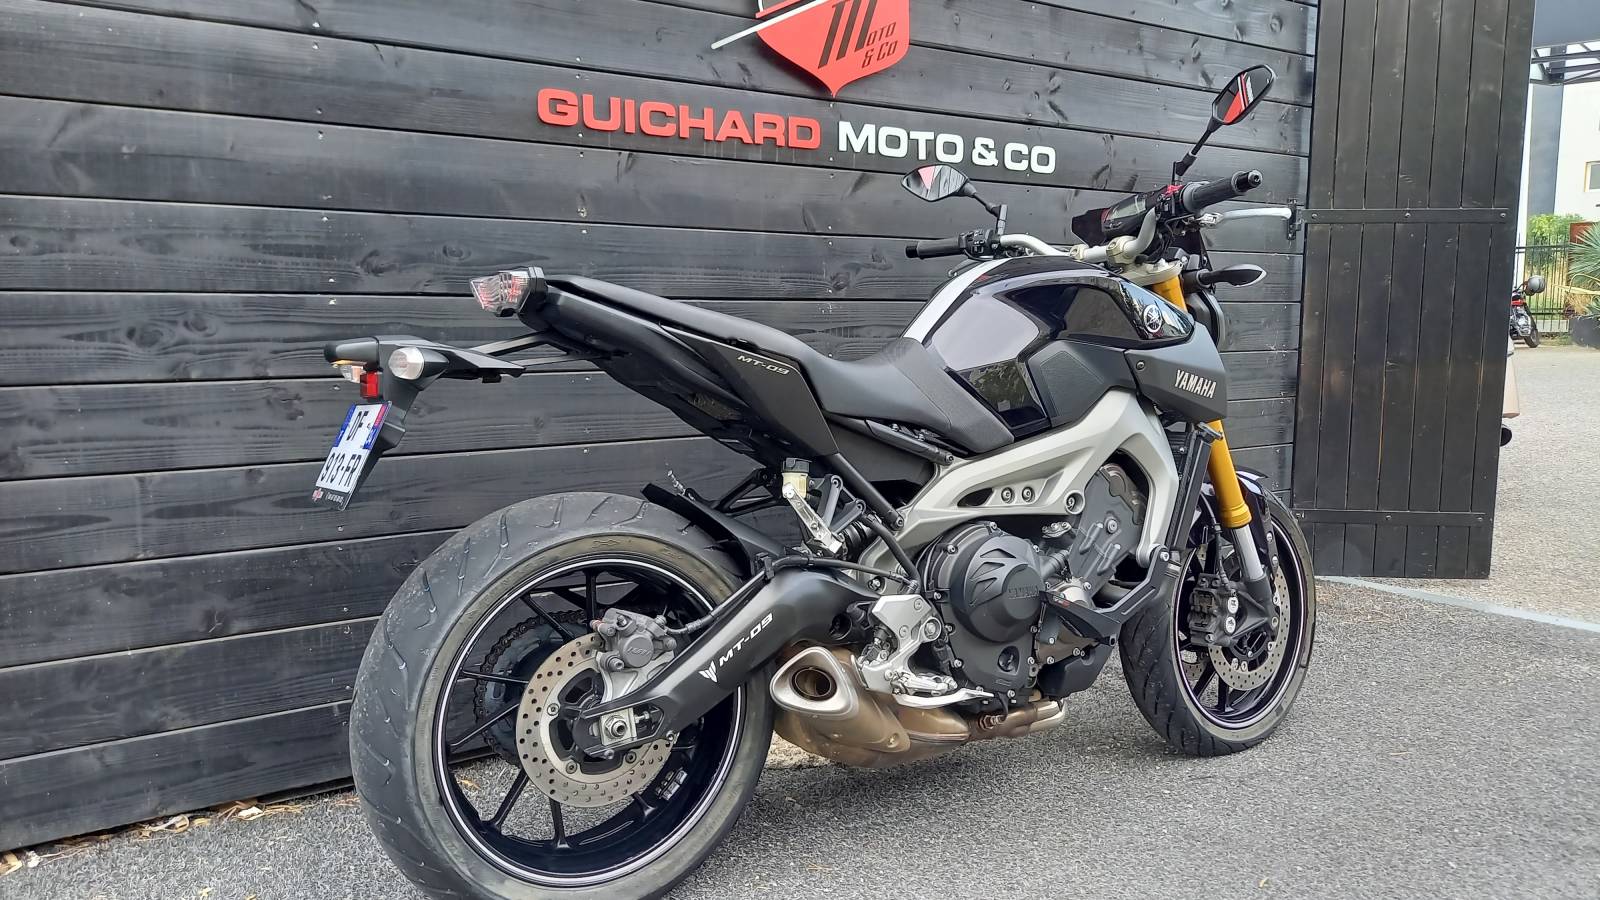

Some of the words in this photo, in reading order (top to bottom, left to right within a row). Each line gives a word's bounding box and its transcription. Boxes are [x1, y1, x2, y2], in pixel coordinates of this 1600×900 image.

[536, 88, 821, 150] GUICHARD
[837, 120, 964, 165] MOTO
[971, 136, 998, 168] &
[1003, 142, 1056, 175] CO
[737, 355, 790, 375] MT-09
[1174, 369, 1217, 399] YAMAHA
[320, 452, 362, 487] 913-FR
[719, 612, 773, 667] MT-09
